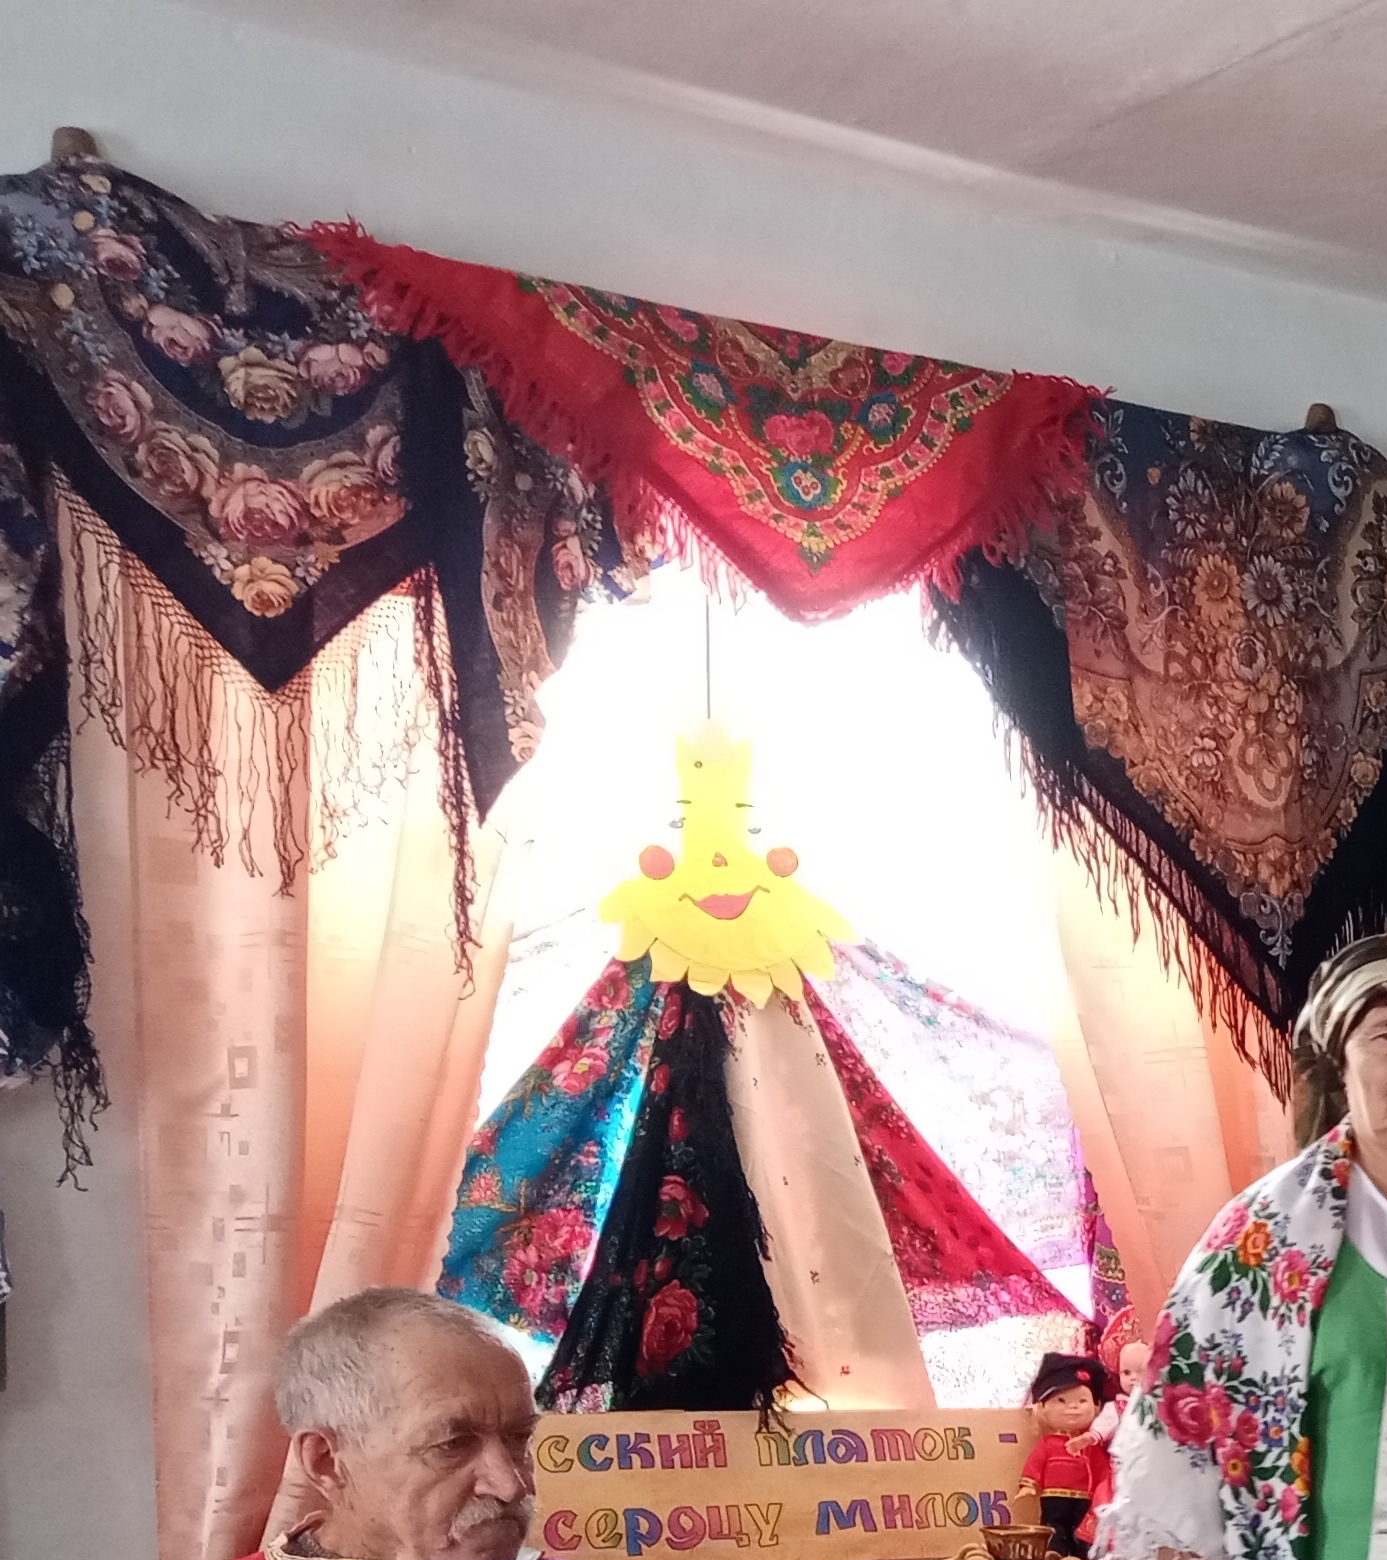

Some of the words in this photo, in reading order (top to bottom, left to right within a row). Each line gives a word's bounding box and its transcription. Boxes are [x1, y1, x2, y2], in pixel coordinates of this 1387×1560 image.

[536, 1418, 729, 1475] сский
[755, 1425, 976, 1468] платок
[542, 1502, 784, 1558] сердцу
[814, 1489, 1014, 1536] милок
